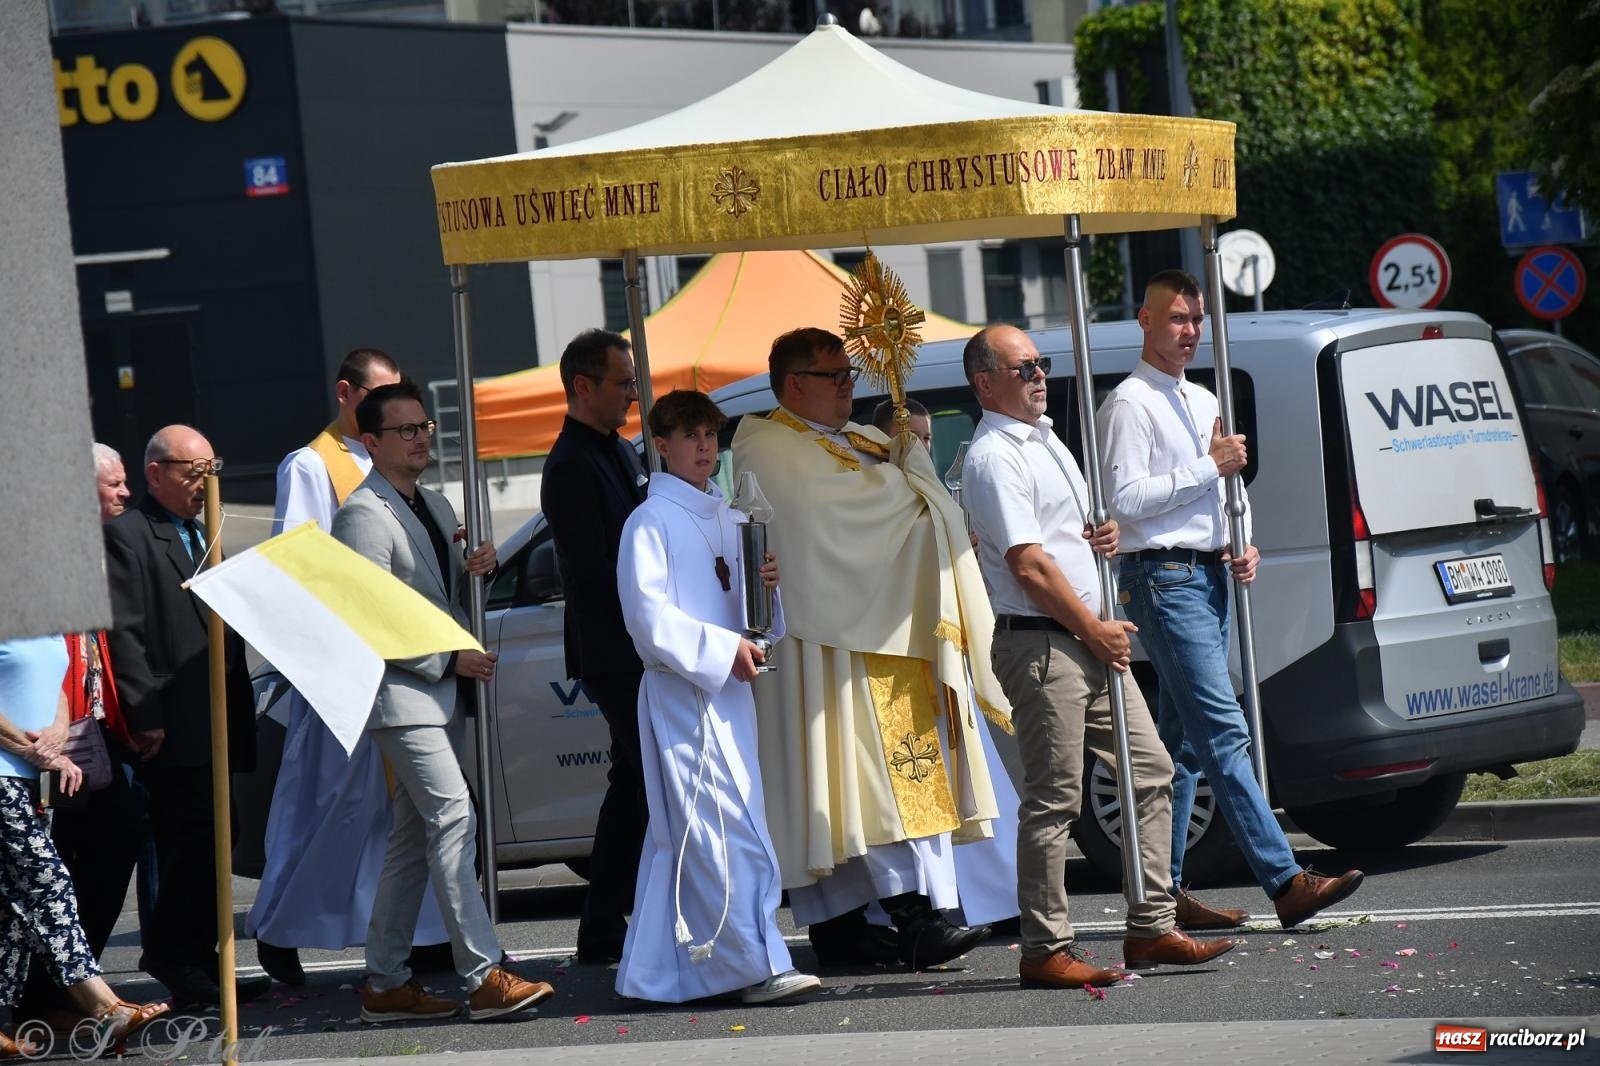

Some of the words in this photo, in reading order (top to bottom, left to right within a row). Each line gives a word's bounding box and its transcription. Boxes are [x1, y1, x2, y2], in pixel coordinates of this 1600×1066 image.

[252, 165, 279, 187] 84
[513, 183, 595, 224] UŚWIĘĆ
[604, 181, 661, 217] MNIE
[819, 163, 887, 201] CIAŁO
[906, 149, 1079, 194] CHRYSTUSOWE
[1096, 148, 1135, 180] ZBAW
[1143, 148, 1167, 180] MNIE
[1383, 261, 1437, 293] 2,5t
[1364, 380, 1514, 431] WASEL
[1481, 559, 1508, 585] 1980
[1405, 664, 1554, 716] www.wasel-krane.de
